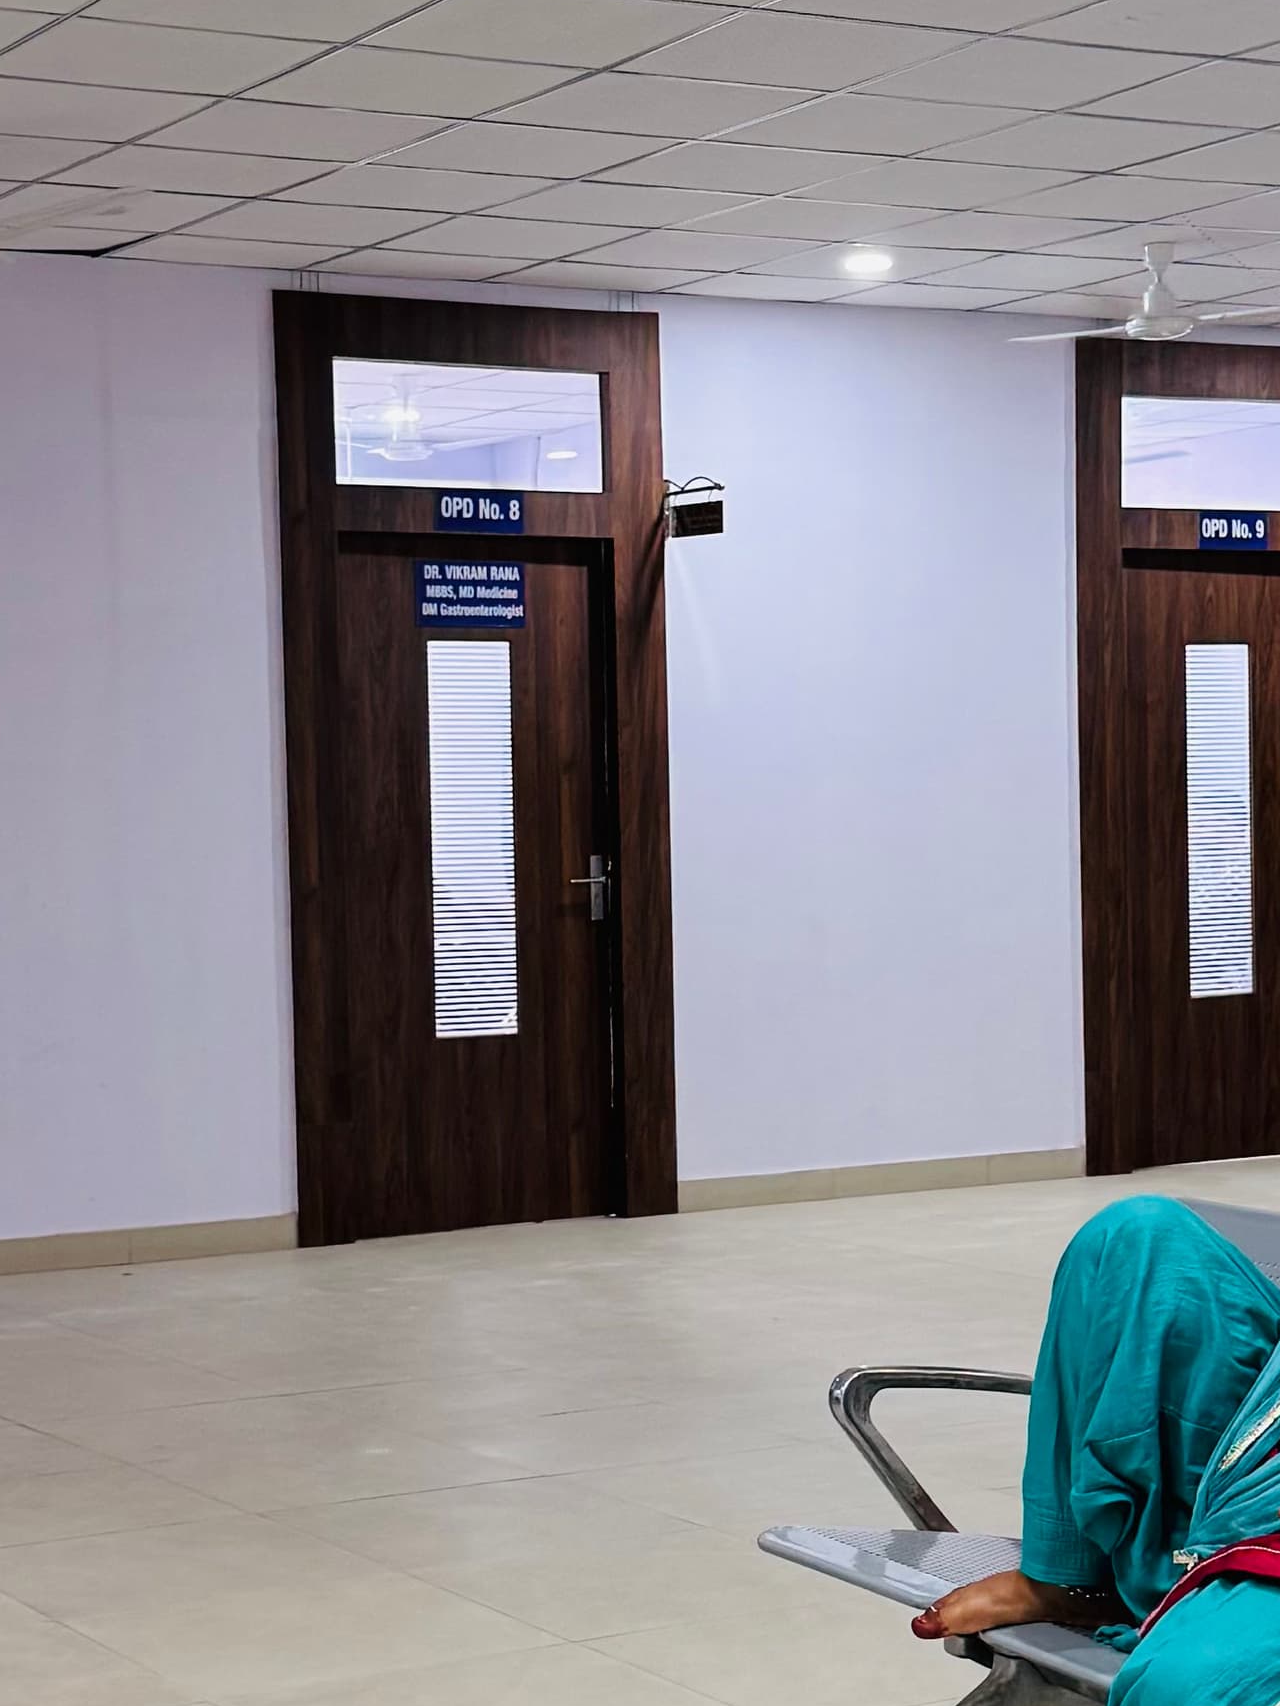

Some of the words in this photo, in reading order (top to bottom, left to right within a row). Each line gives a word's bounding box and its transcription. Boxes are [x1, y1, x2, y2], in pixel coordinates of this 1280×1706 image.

[441, 496, 473, 518] OPD
[478, 498, 504, 520] No.
[509, 500, 520, 521] 8
[1202, 518, 1228, 538] OPD
[1231, 519, 1252, 539] No.
[1255, 520, 1265, 539] 9
[424, 565, 442, 579] DR.
[444, 565, 488, 581] VIKRAM
[490, 566, 520, 581] RANA
[426, 585, 456, 600] MBBS,
[458, 586, 475, 599] MD
[476, 586, 518, 599] Medicine
[422, 603, 438, 616] DM
[440, 603, 524, 619] Gastroenterologist
